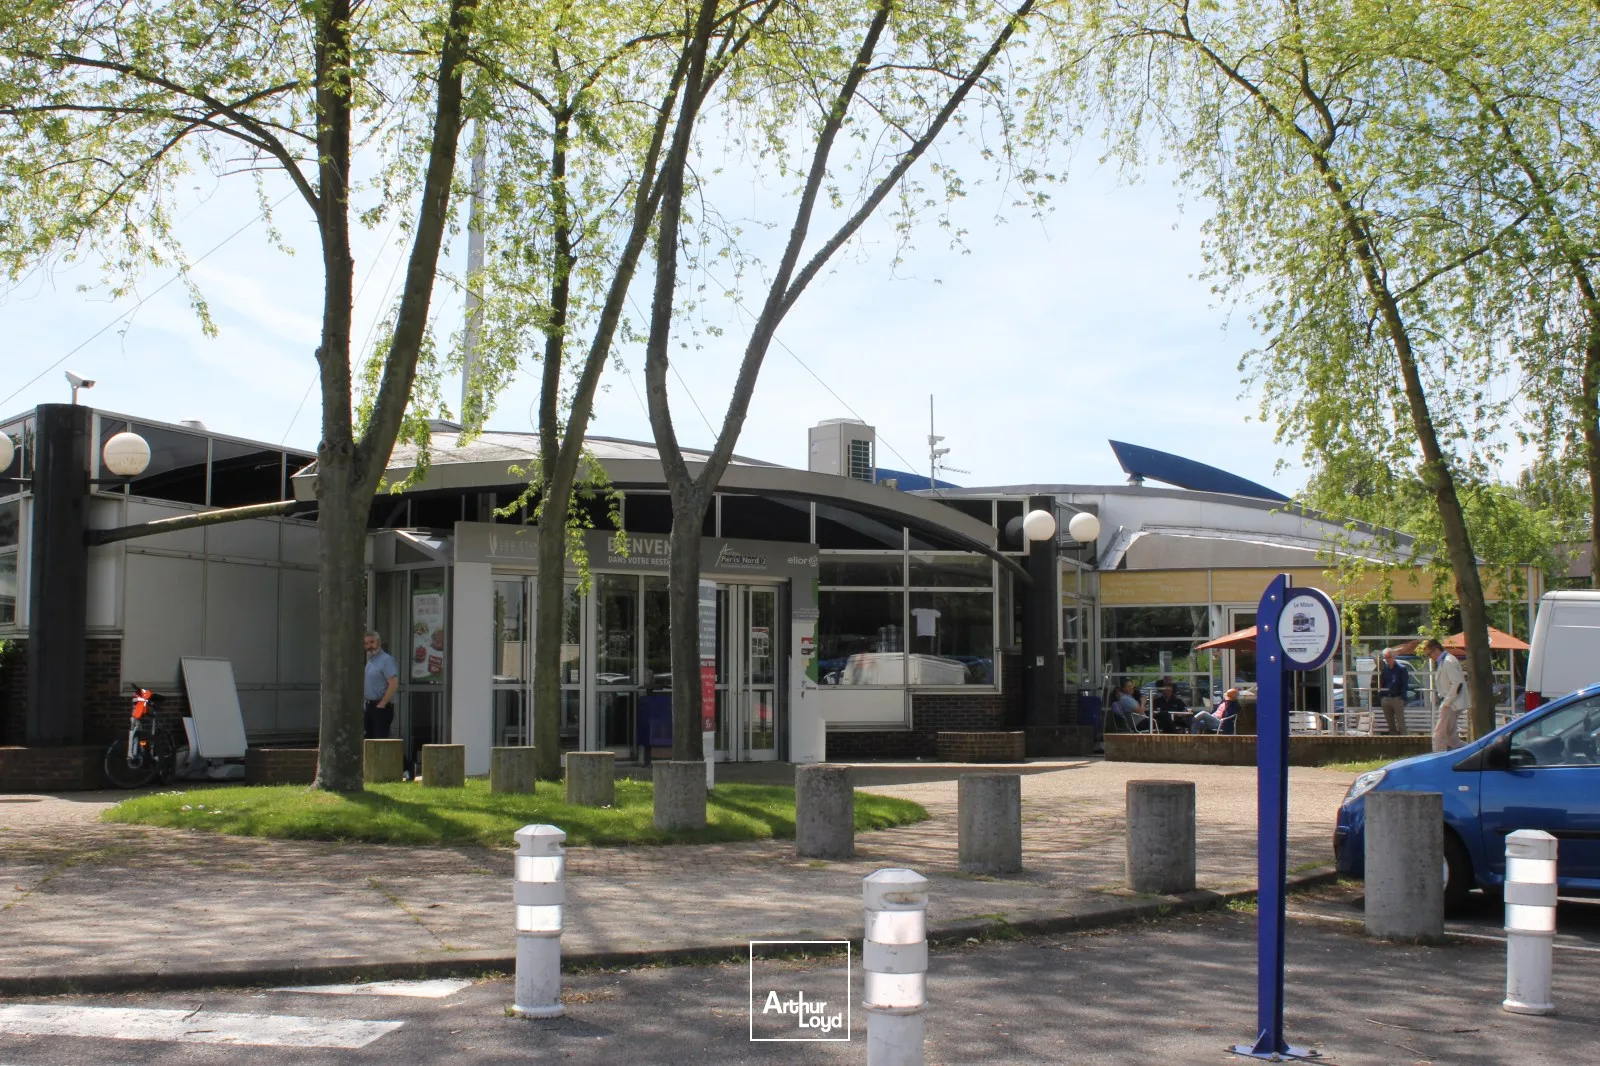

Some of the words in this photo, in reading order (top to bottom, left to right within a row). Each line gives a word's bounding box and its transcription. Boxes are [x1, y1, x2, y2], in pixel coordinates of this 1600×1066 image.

[607, 536, 671, 554] BENVEN
[628, 556, 649, 565] VOTRE
[721, 555, 740, 563] Paris
[742, 556, 759, 564] Nord
